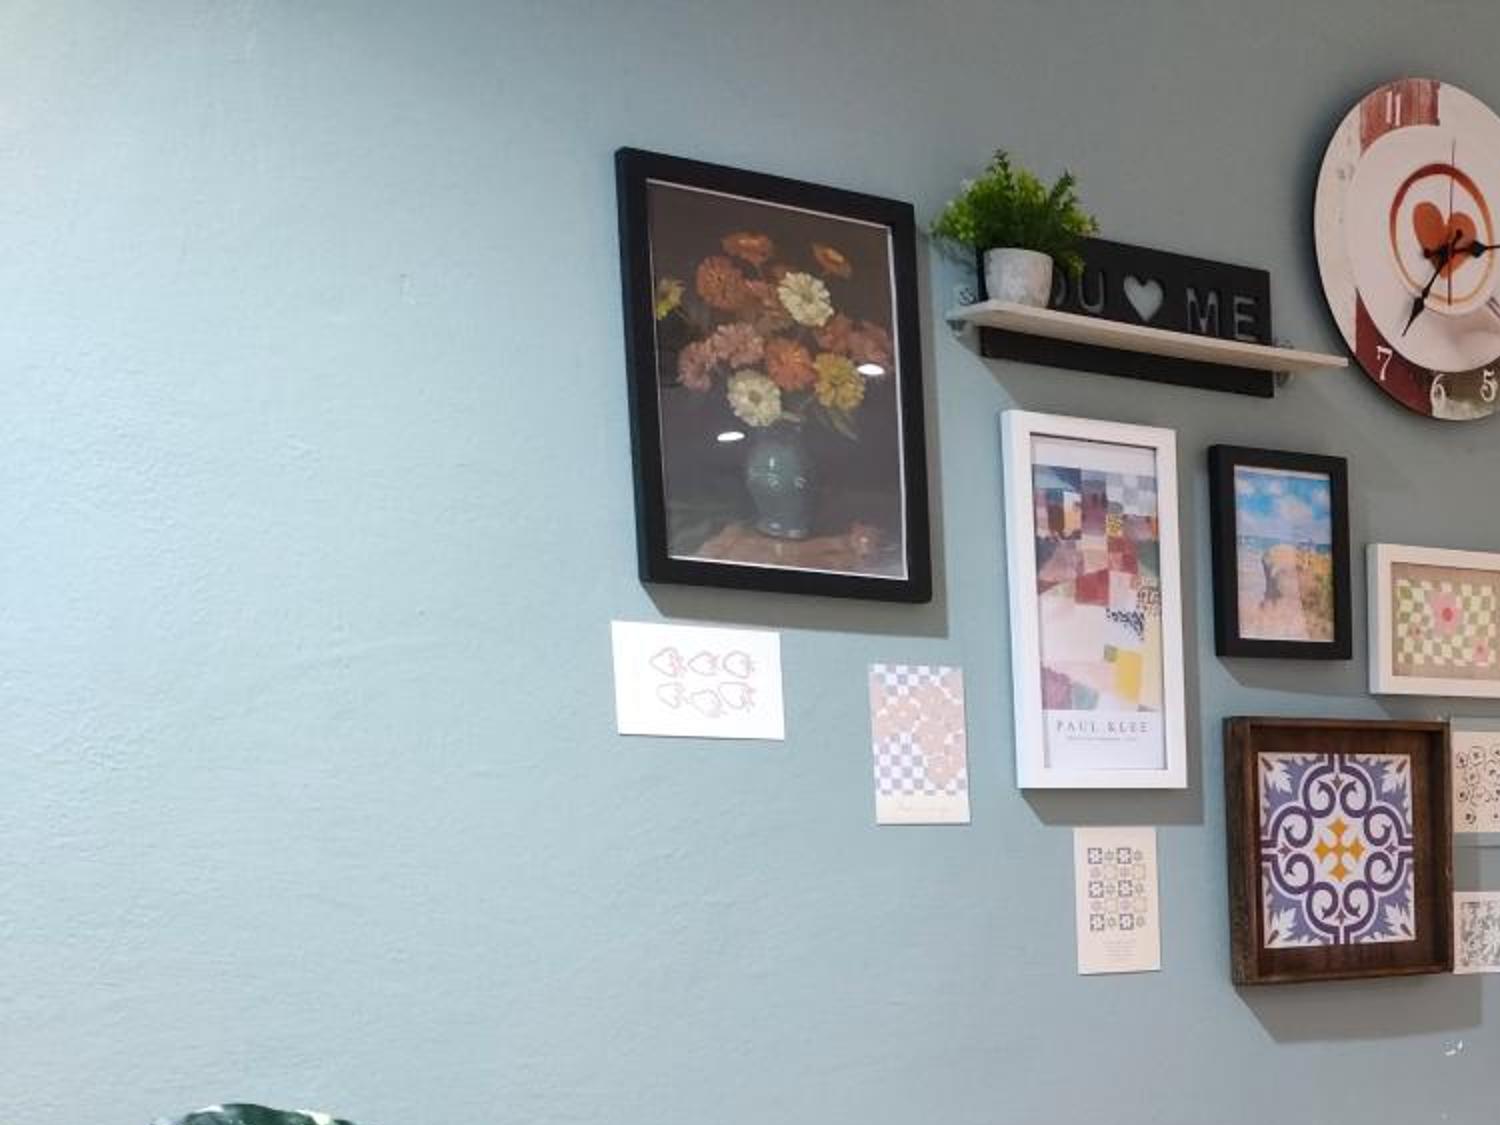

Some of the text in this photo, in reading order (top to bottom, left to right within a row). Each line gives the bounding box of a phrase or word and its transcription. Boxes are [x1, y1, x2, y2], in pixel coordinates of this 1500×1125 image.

[1185, 286, 1258, 343] ME
[1375, 345, 1393, 381] 7
[1429, 372, 1446, 405] 6
[1480, 370, 1498, 402] 5
[1056, 719, 1150, 734] PAUL KLEE
